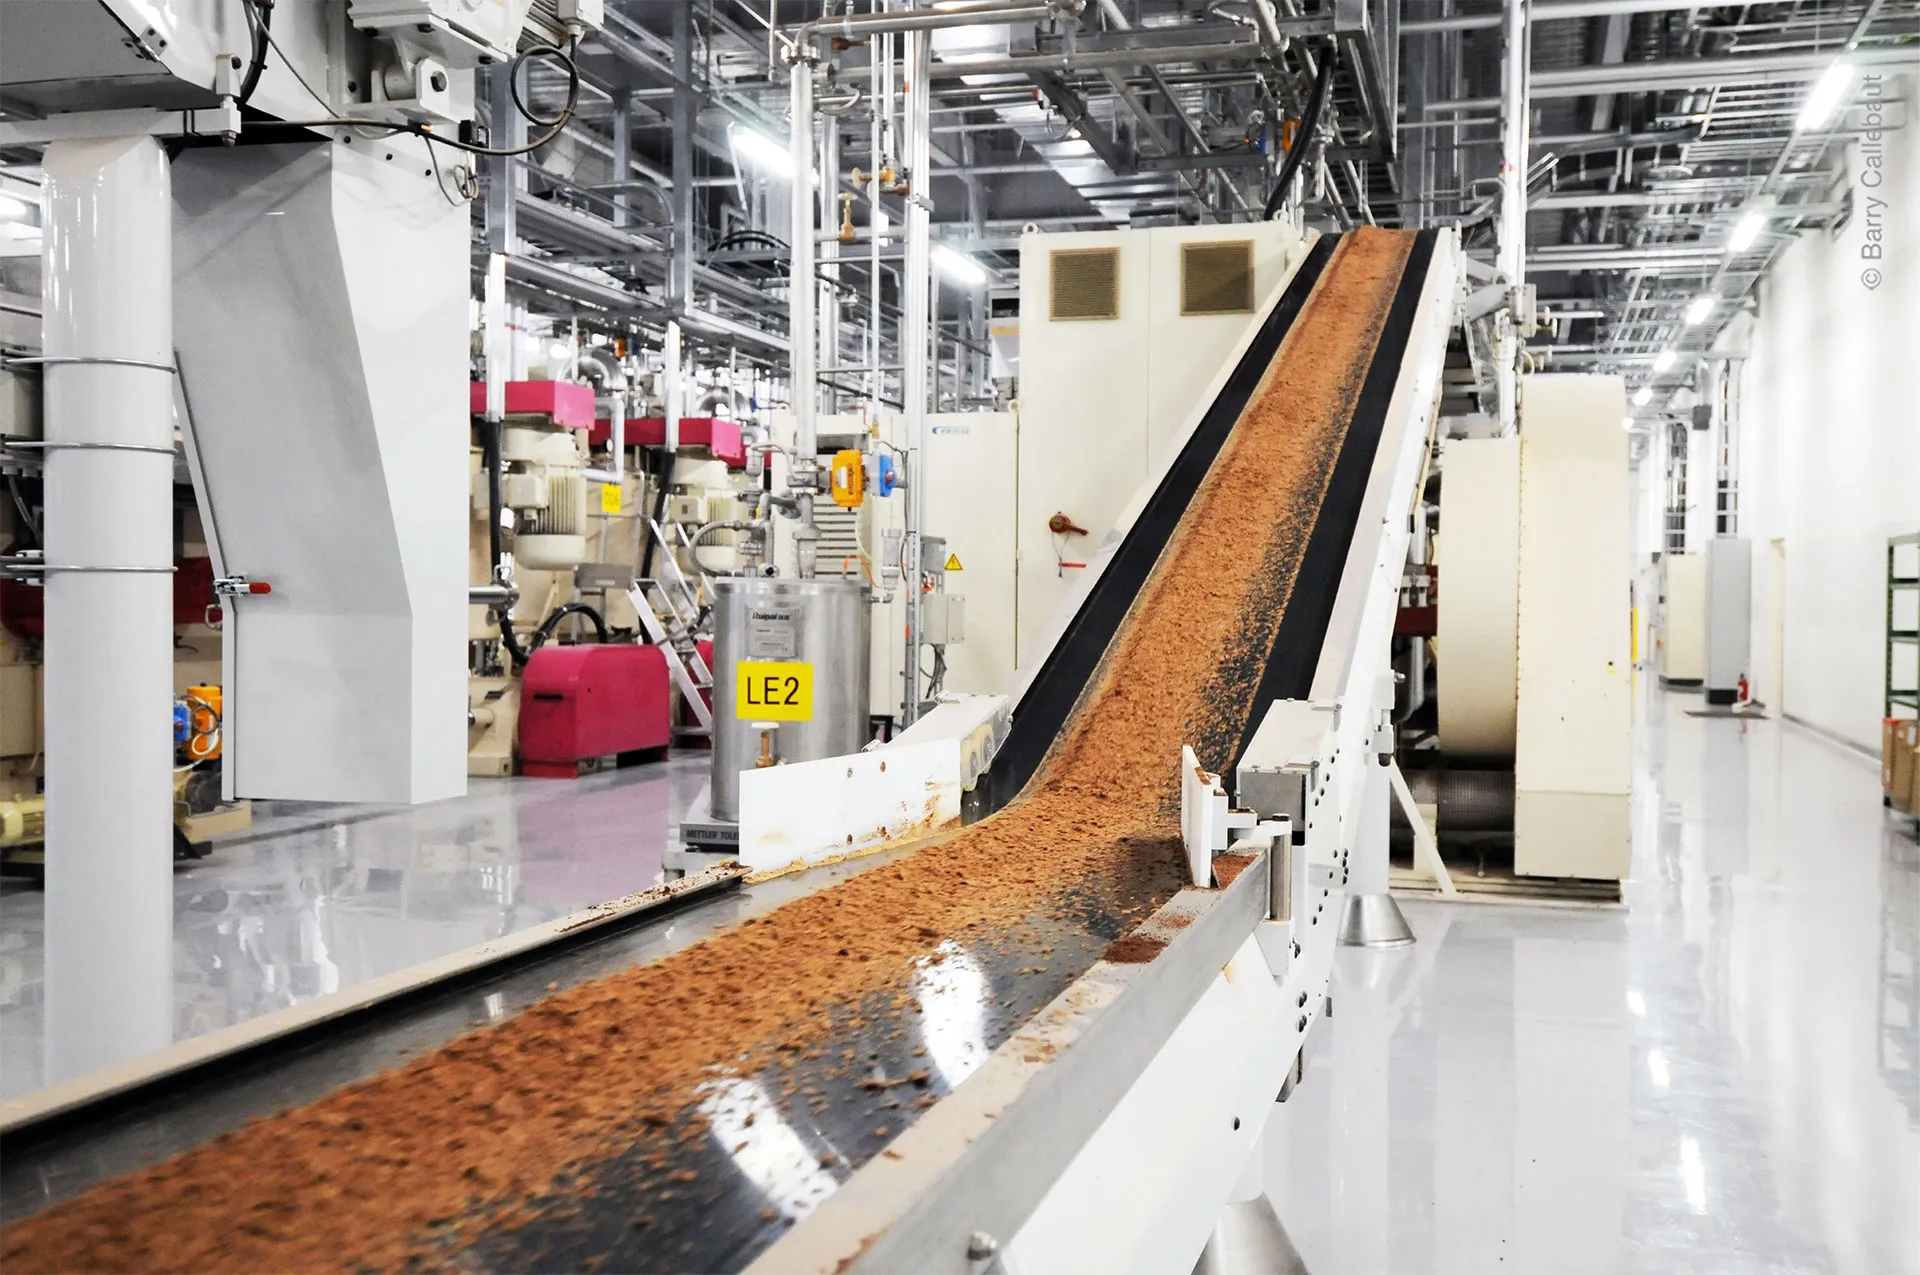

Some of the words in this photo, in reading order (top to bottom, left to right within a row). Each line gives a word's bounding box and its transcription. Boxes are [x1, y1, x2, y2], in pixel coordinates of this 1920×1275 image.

[747, 676, 799, 705] LE2
[686, 829, 717, 839] METTLER
[721, 831, 739, 841] TOLE
